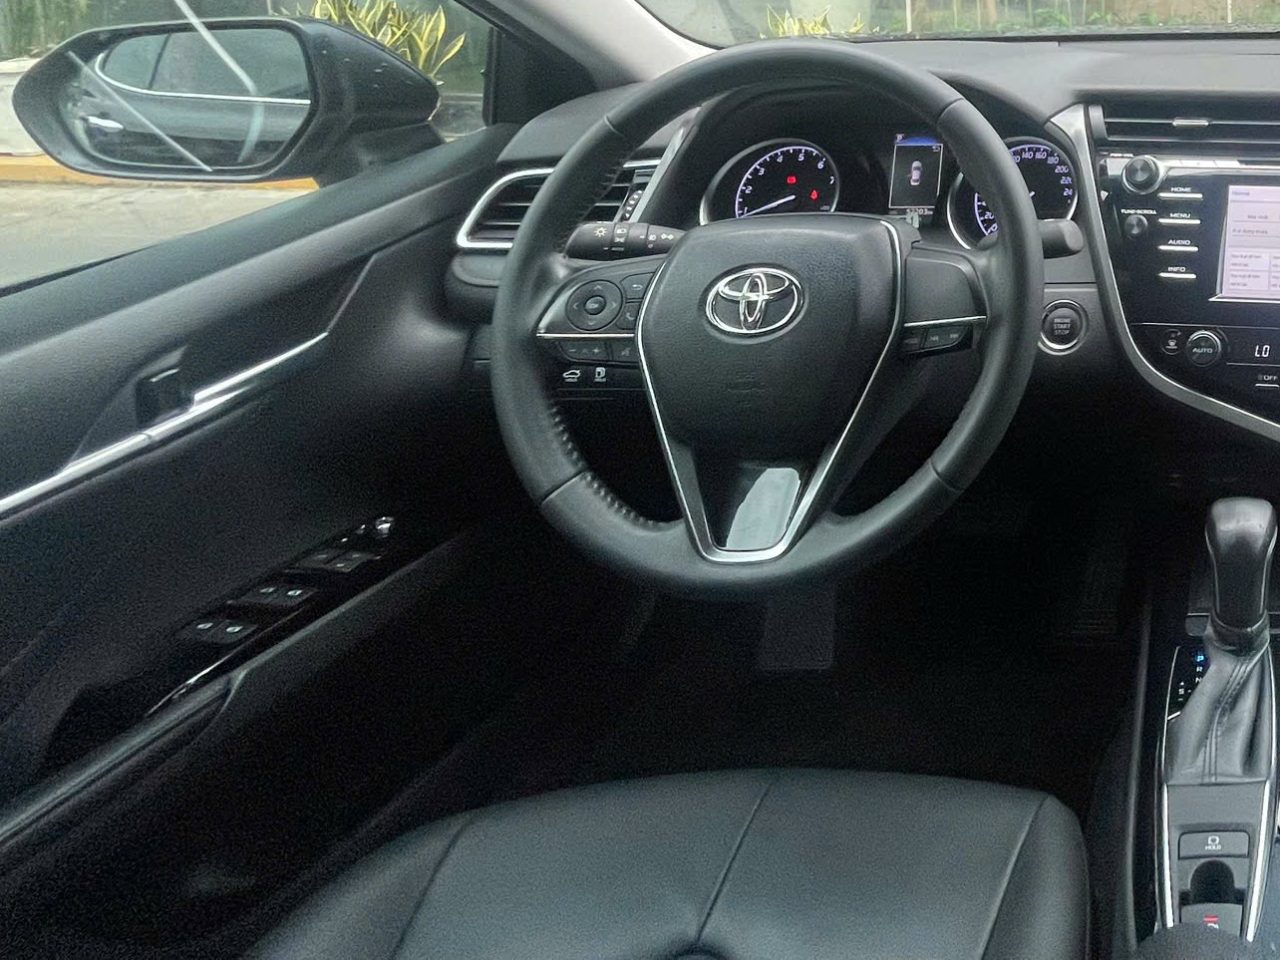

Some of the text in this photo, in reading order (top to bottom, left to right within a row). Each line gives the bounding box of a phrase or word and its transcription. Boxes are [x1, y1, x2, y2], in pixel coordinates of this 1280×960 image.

[817, 161, 824, 170] 6
[758, 167, 765, 176] 3
[745, 185, 752, 194] 2
